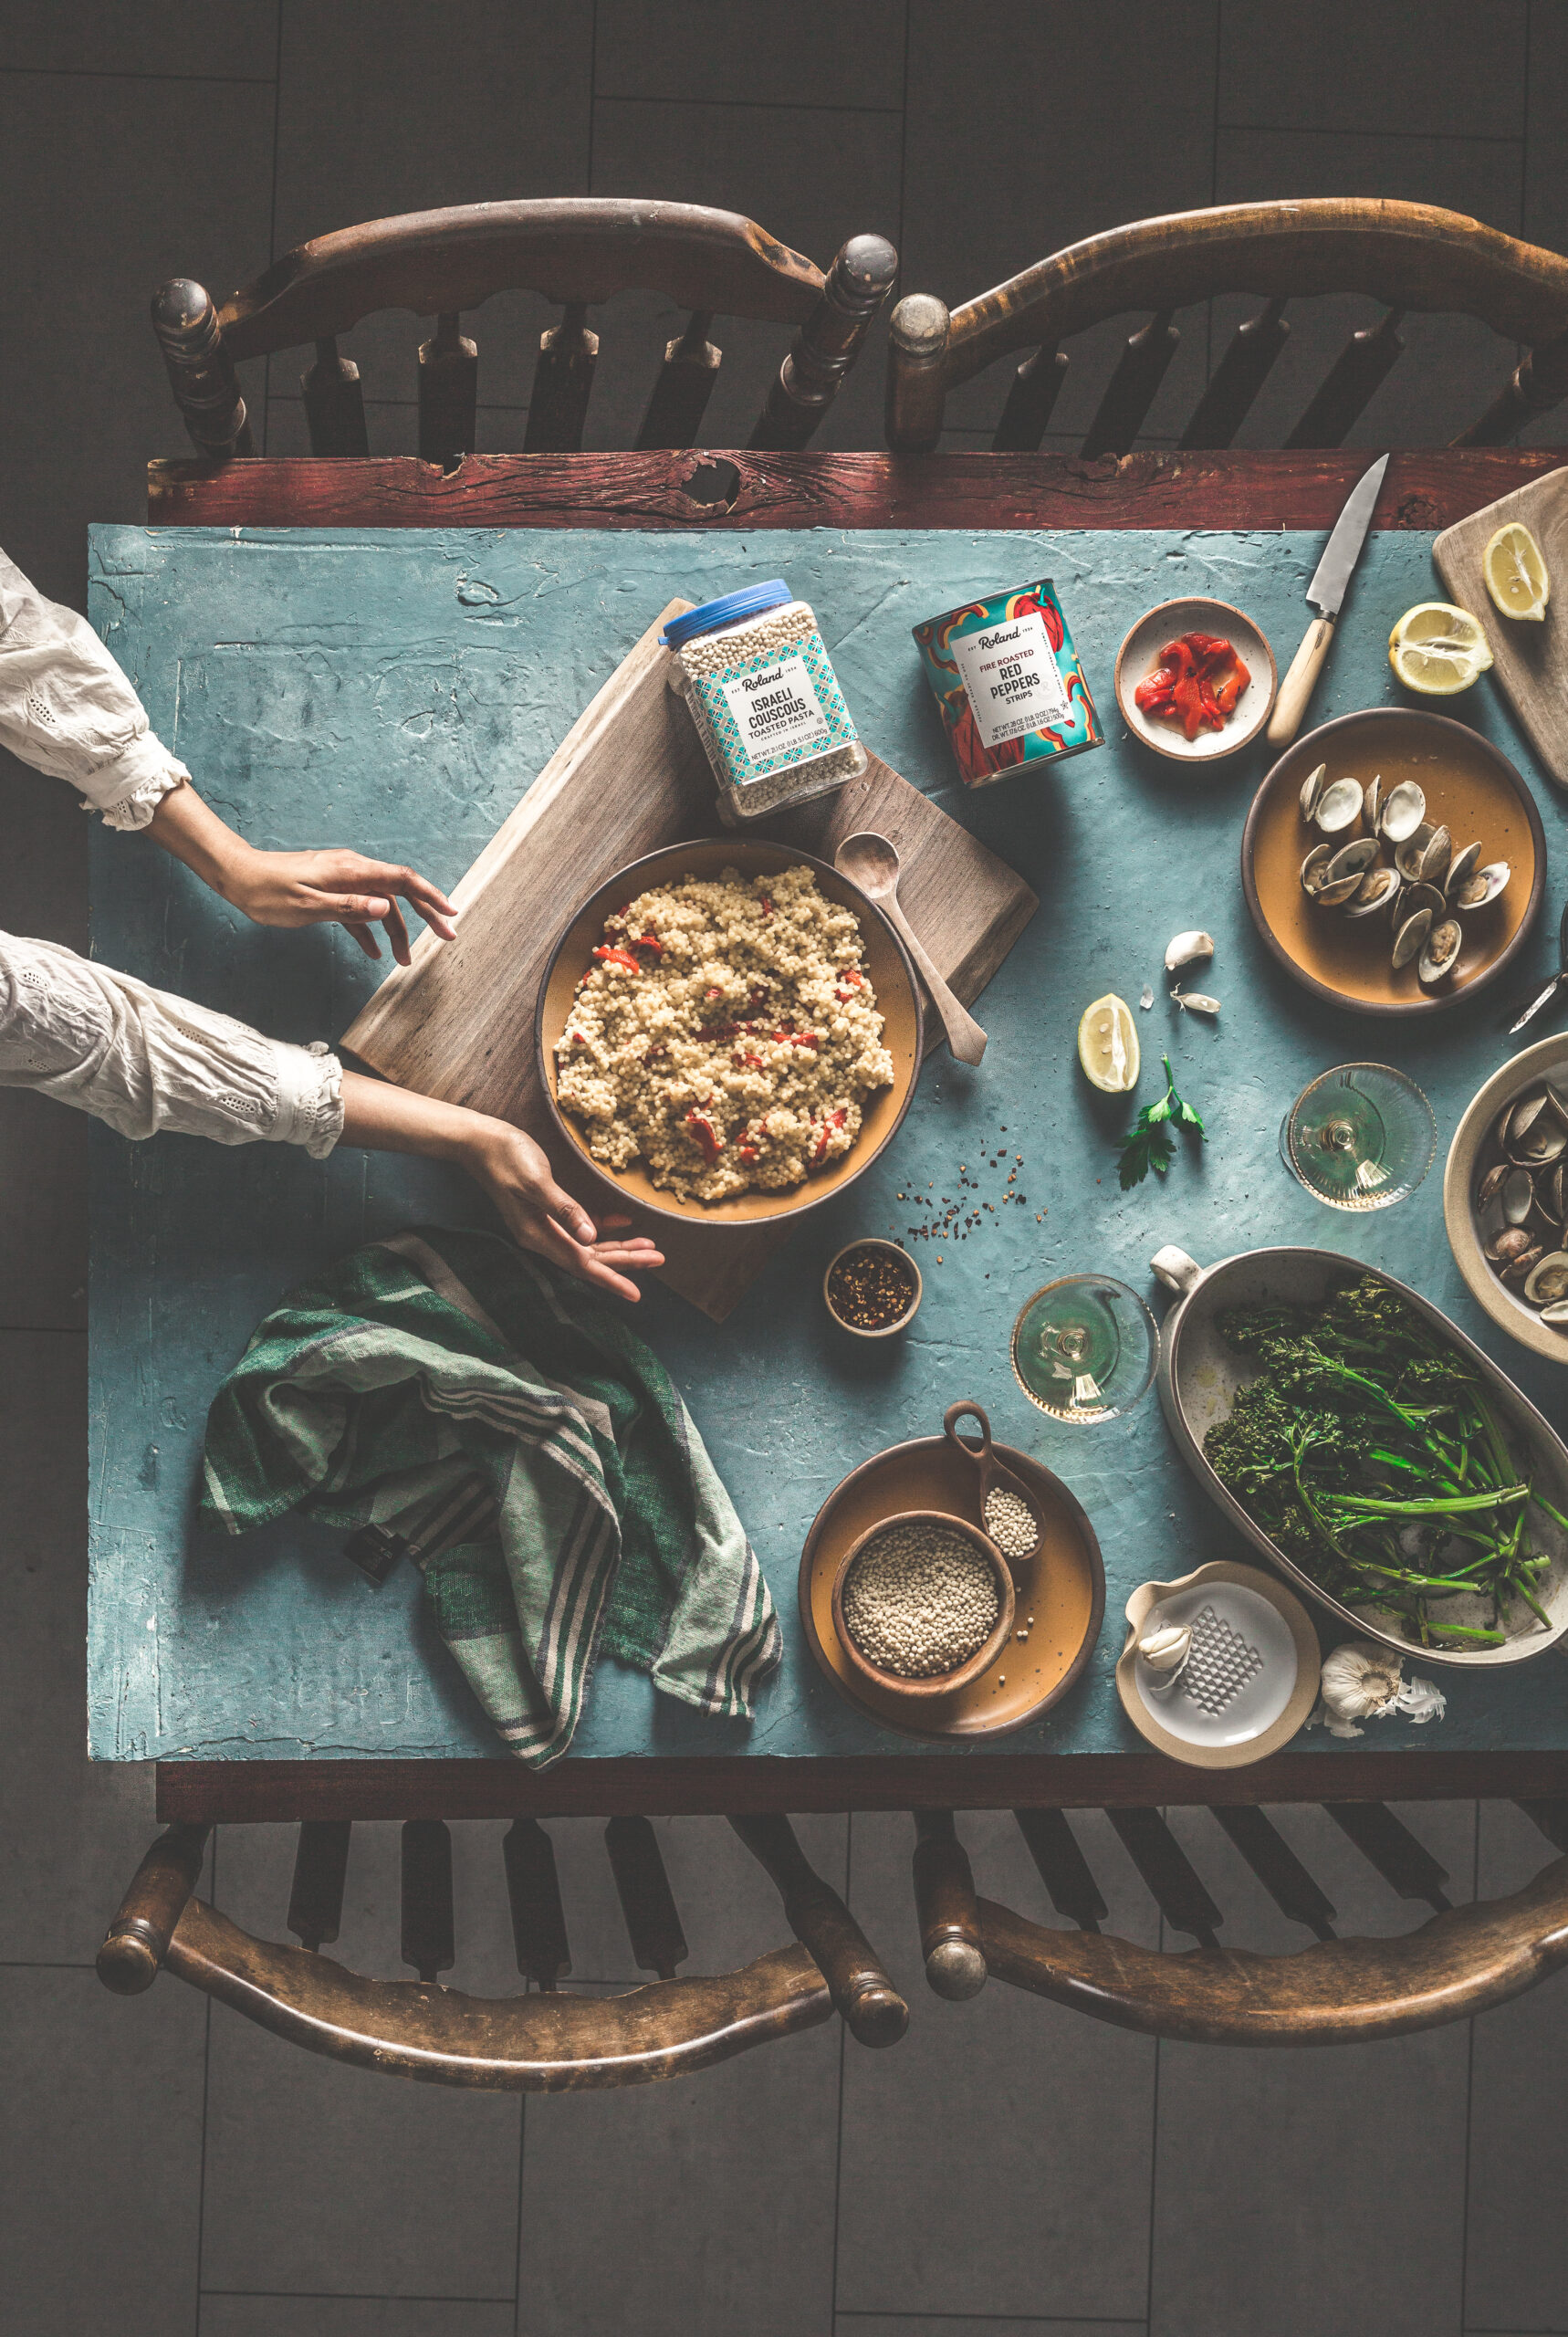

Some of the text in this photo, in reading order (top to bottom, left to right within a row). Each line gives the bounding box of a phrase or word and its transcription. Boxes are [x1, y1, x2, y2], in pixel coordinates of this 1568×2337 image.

[978, 626, 1021, 650] Roland
[979, 649, 1034, 672] FIRE ROASTED
[999, 663, 1022, 680] RED
[742, 667, 784, 692] Roland
[990, 673, 1040, 699] PEPPERS
[751, 687, 793, 713] ISRAELI
[1006, 690, 1033, 704] STRIPS
[748, 698, 806, 729] COUSCOUS
[748, 710, 815, 739] TOASTED PASTA
[814, 728, 827, 737] 600g
[993, 725, 1001, 733] NET
